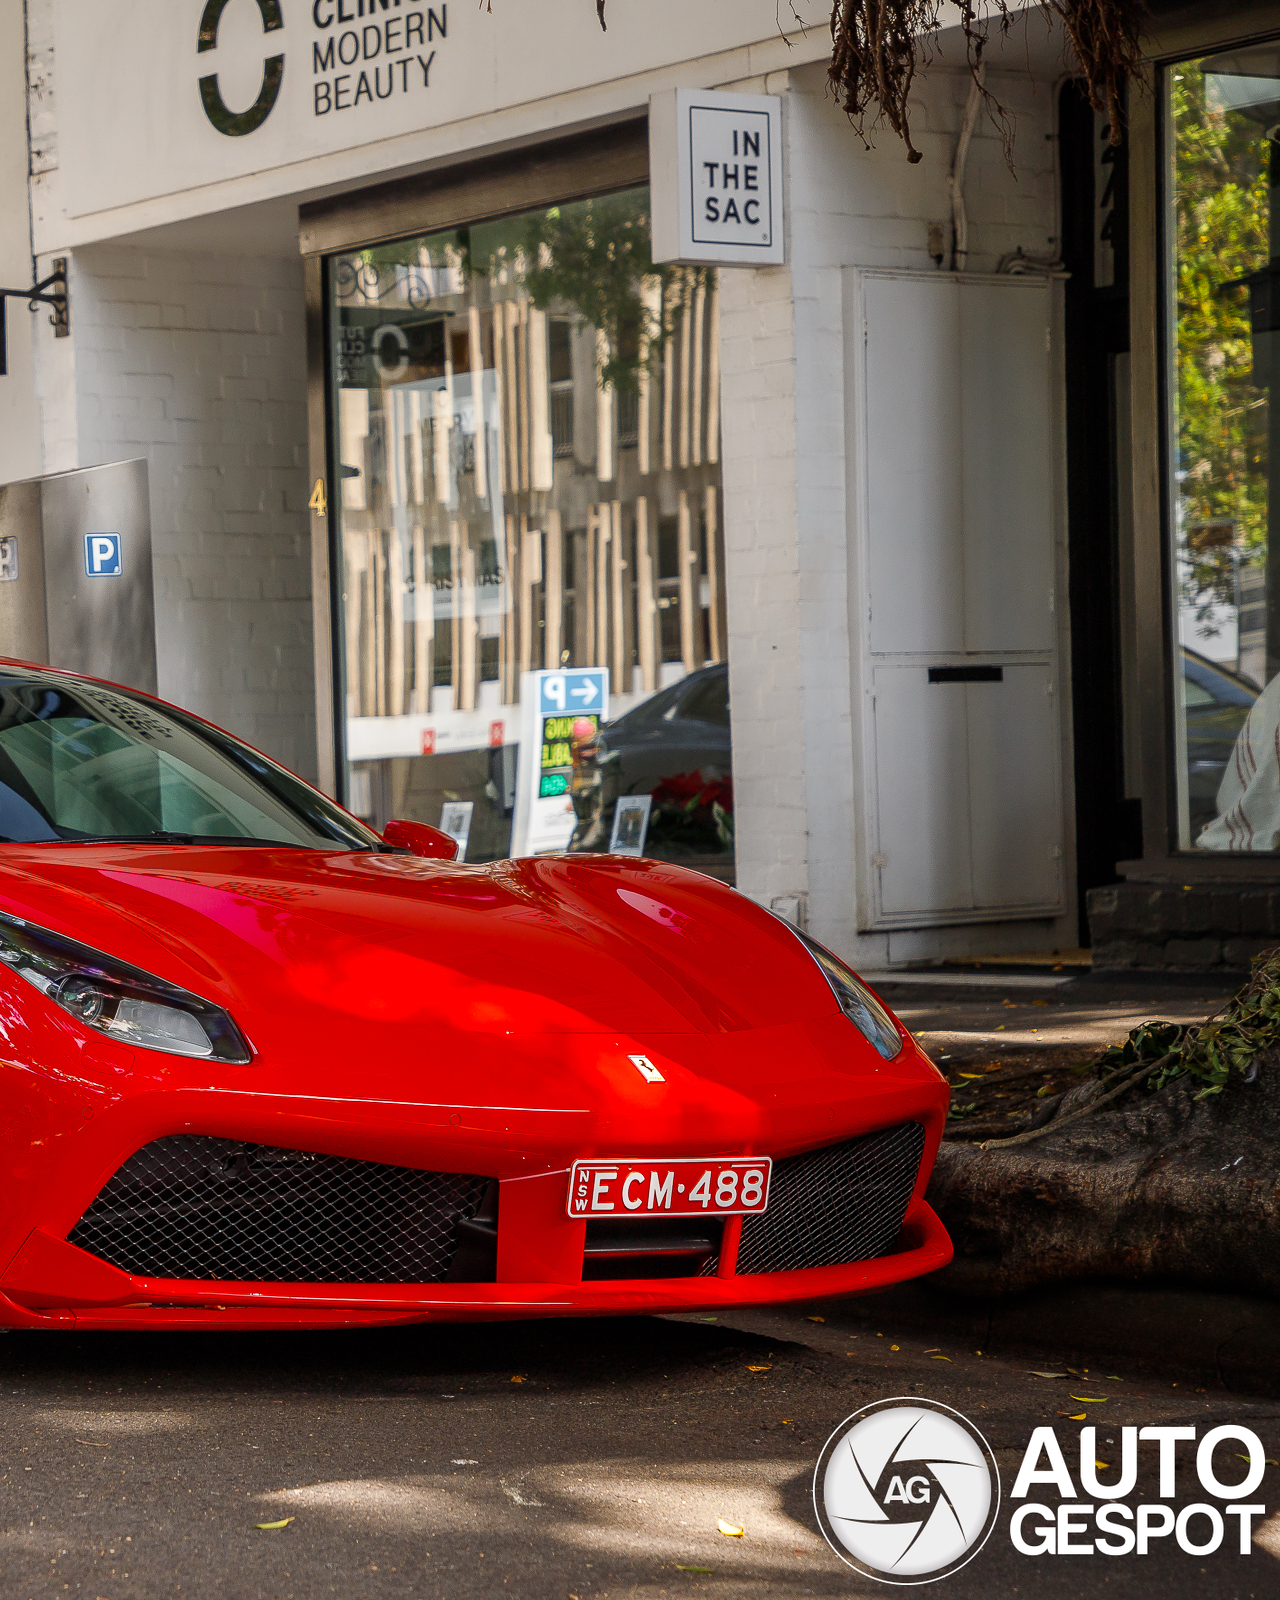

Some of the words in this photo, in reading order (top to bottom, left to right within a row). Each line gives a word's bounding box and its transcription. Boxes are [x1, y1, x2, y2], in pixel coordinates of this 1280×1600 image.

[313, 3, 447, 74] MODERN
[314, 50, 436, 117] BEAUTY
[733, 130, 760, 157] IN
[703, 162, 759, 191] THE
[705, 196, 761, 225] SAC
[308, 478, 327, 517] 4
[91, 537, 115, 573] P
[575, 1170, 591, 1212] NSW
